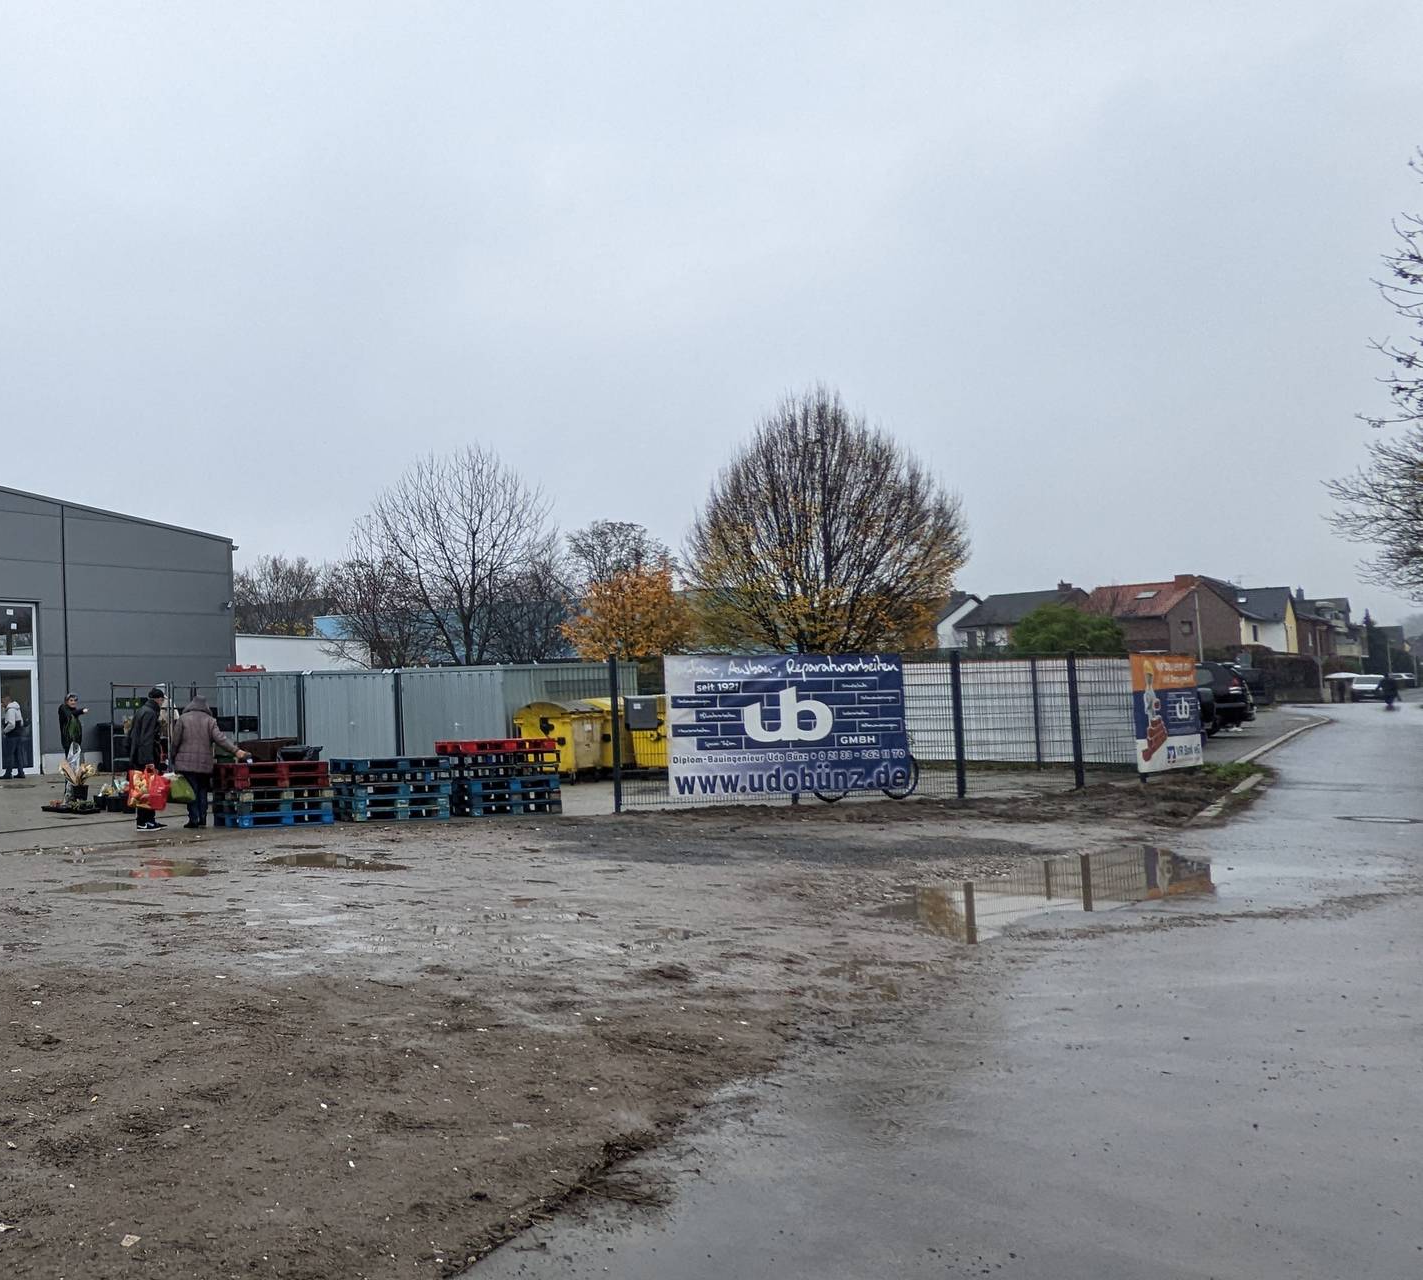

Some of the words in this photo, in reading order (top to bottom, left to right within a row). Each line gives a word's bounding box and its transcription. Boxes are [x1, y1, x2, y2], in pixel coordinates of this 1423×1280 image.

[785, 655, 899, 682] Reparaturarbeiten
[696, 684, 715, 692] seit
[717, 682, 739, 692] 1921
[743, 686, 834, 743] ub
[840, 735, 876, 744] GMBH
[672, 754, 764, 765] Diplom-Bauingenieur
[767, 753, 784, 762] Udo
[787, 751, 809, 762] Bünz
[673, 763, 907, 795] www.udobünz.de
